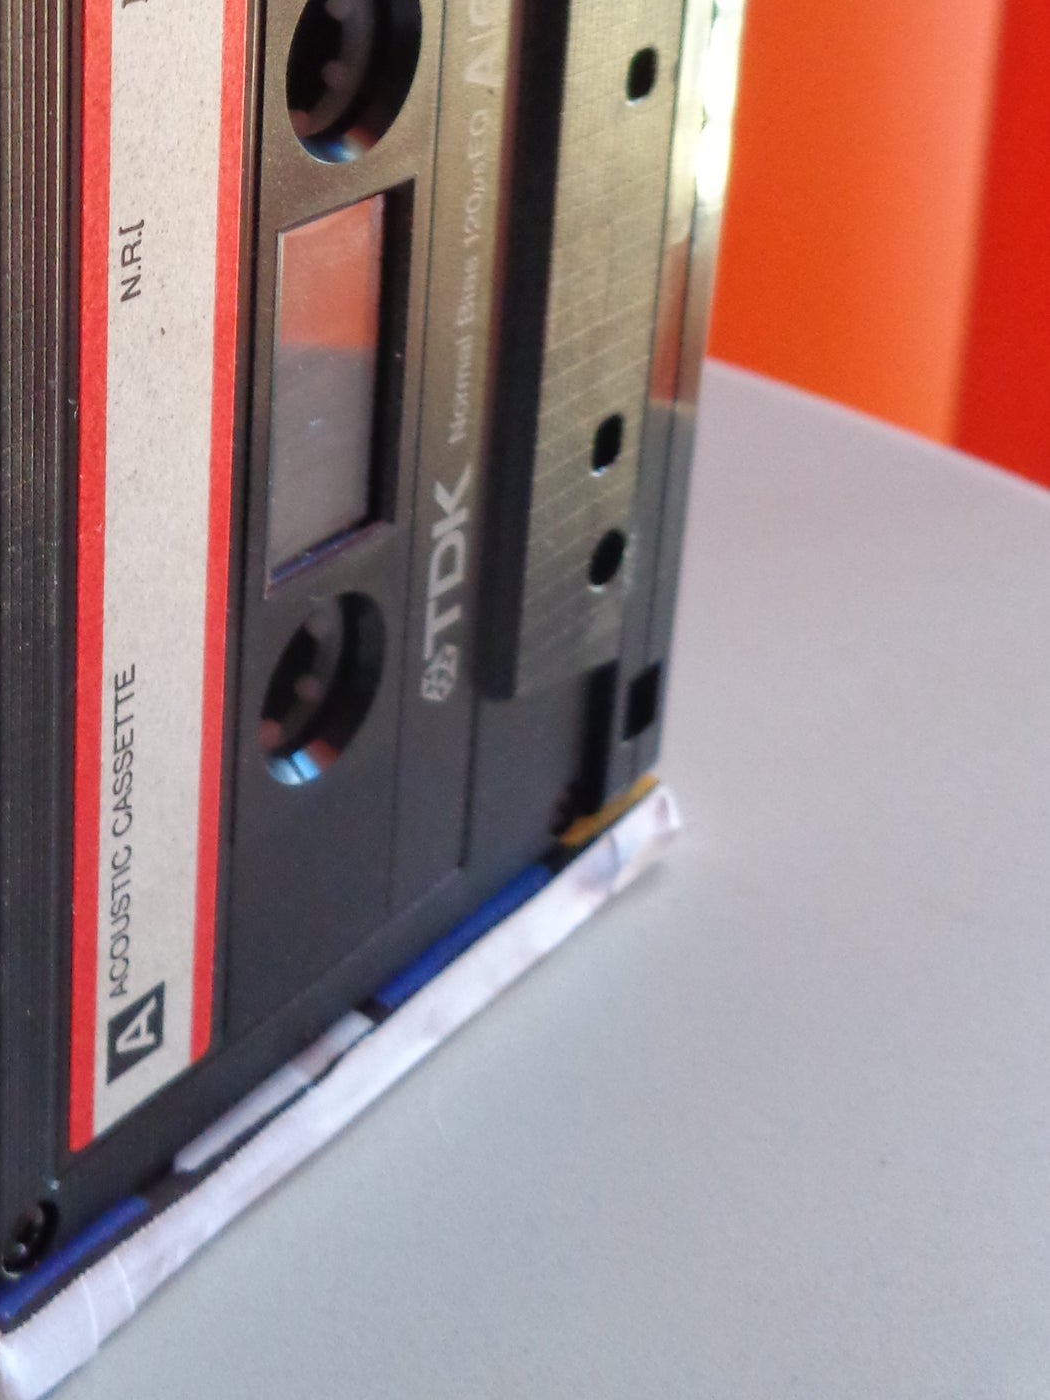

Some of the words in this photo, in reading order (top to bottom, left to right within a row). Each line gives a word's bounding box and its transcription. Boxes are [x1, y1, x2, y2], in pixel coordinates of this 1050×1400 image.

[456, 255, 480, 327] Bias
[447, 334, 473, 445] Normal
[422, 462, 473, 662] TDK
[110, 662, 136, 838] CASSETTE
[108, 844, 133, 999] ACOUSTIC
